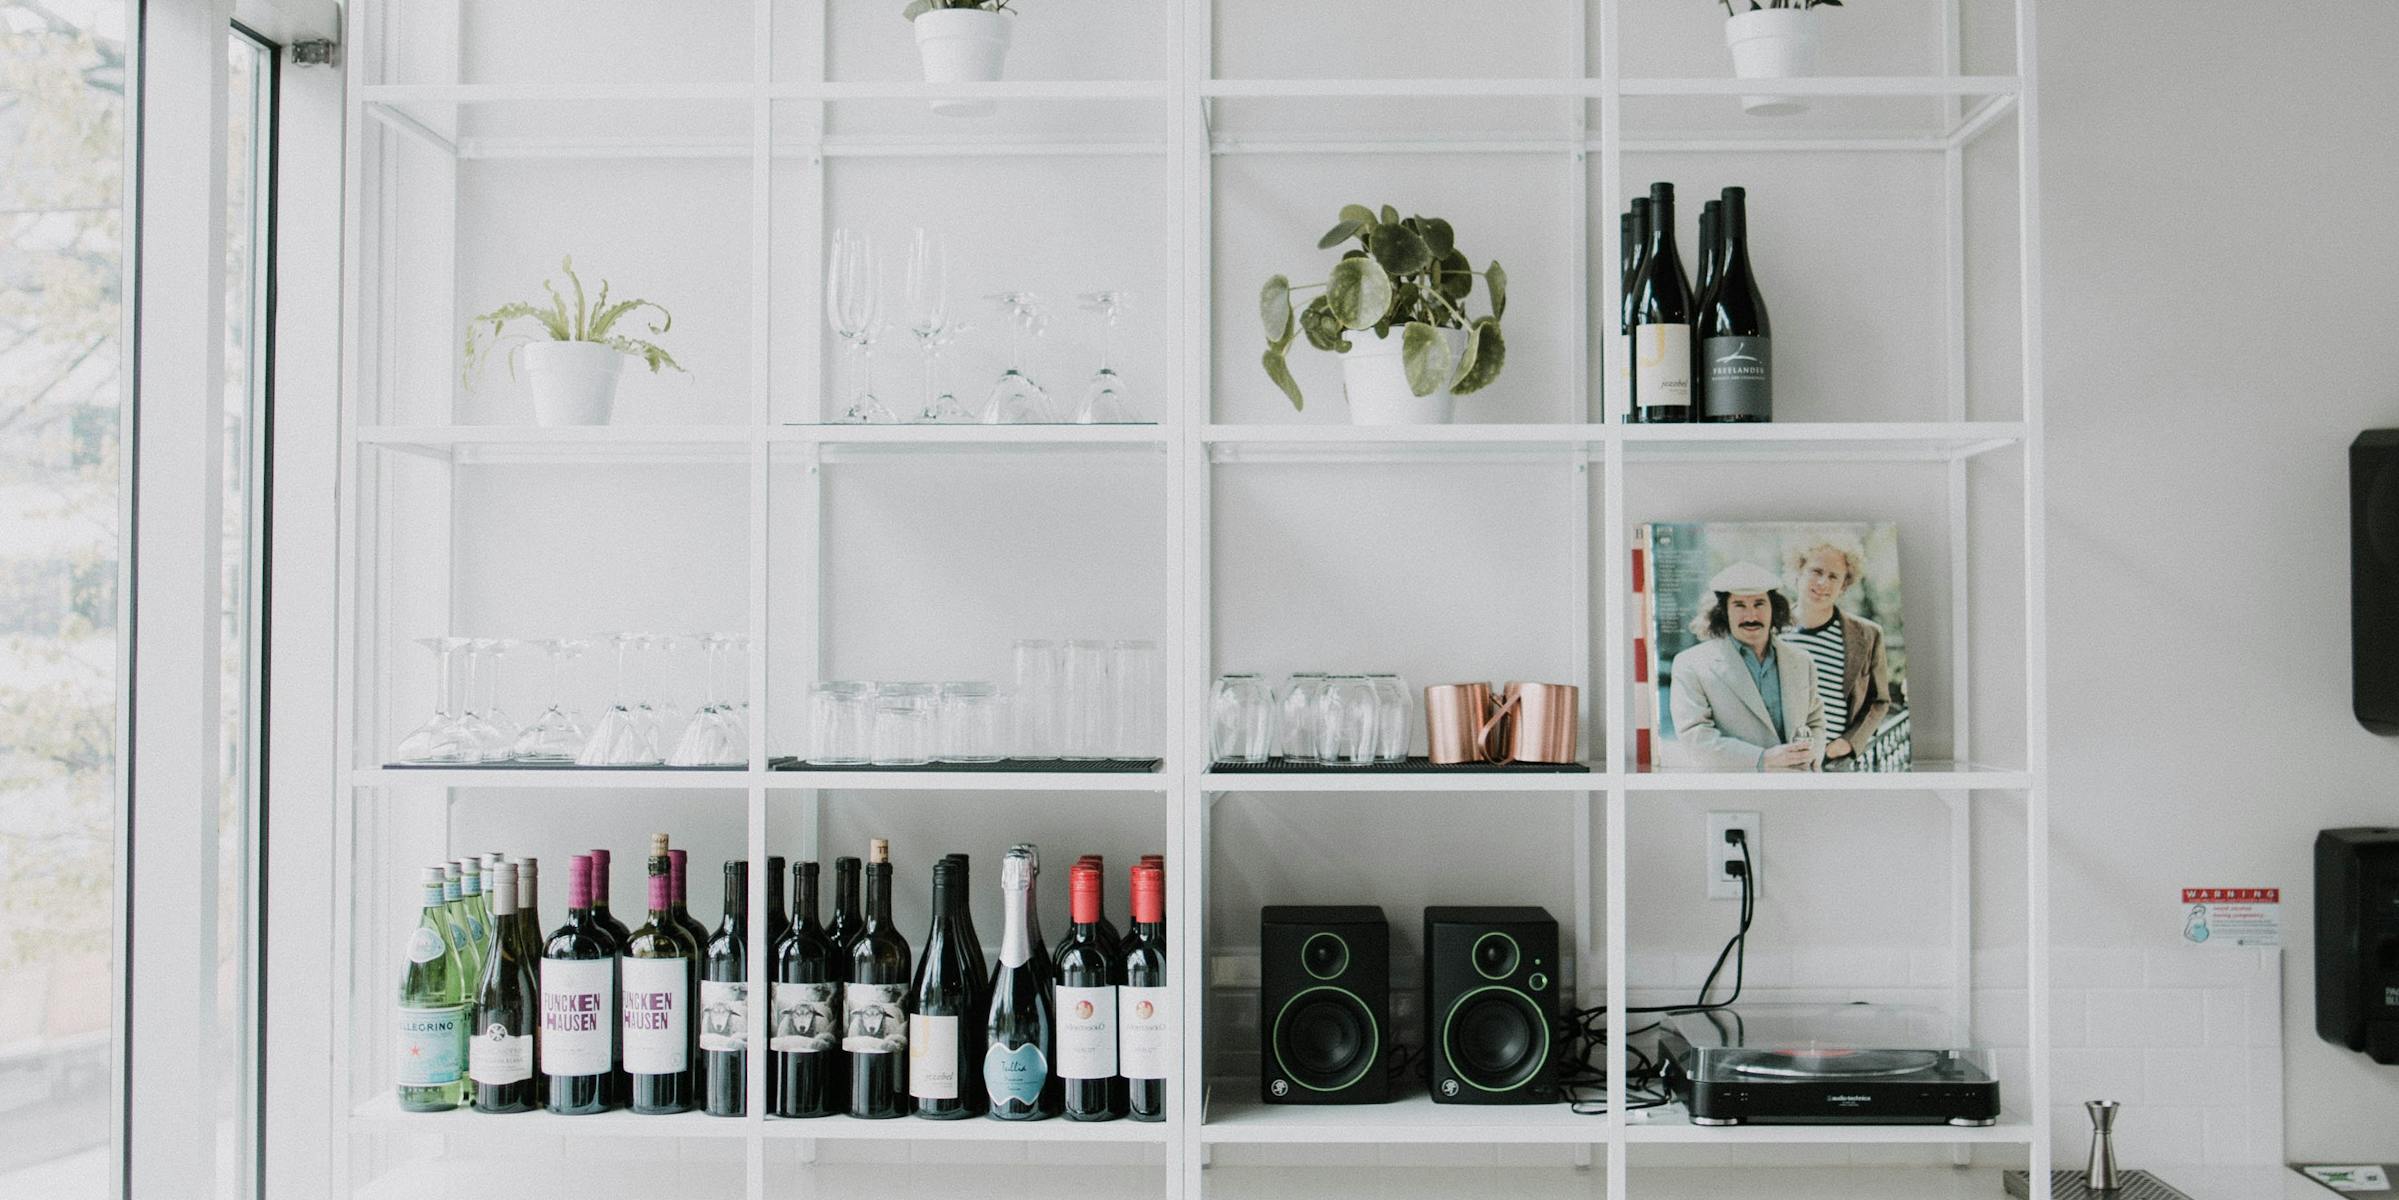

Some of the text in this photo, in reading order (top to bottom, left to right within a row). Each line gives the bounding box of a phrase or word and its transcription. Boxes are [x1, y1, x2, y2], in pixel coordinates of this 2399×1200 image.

[2187, 890, 2274, 898] WARNING
[545, 993, 600, 1012] FUNCKEN
[547, 1013, 597, 1031] HAUSEN
[625, 1011, 668, 1030] HAUSEN
